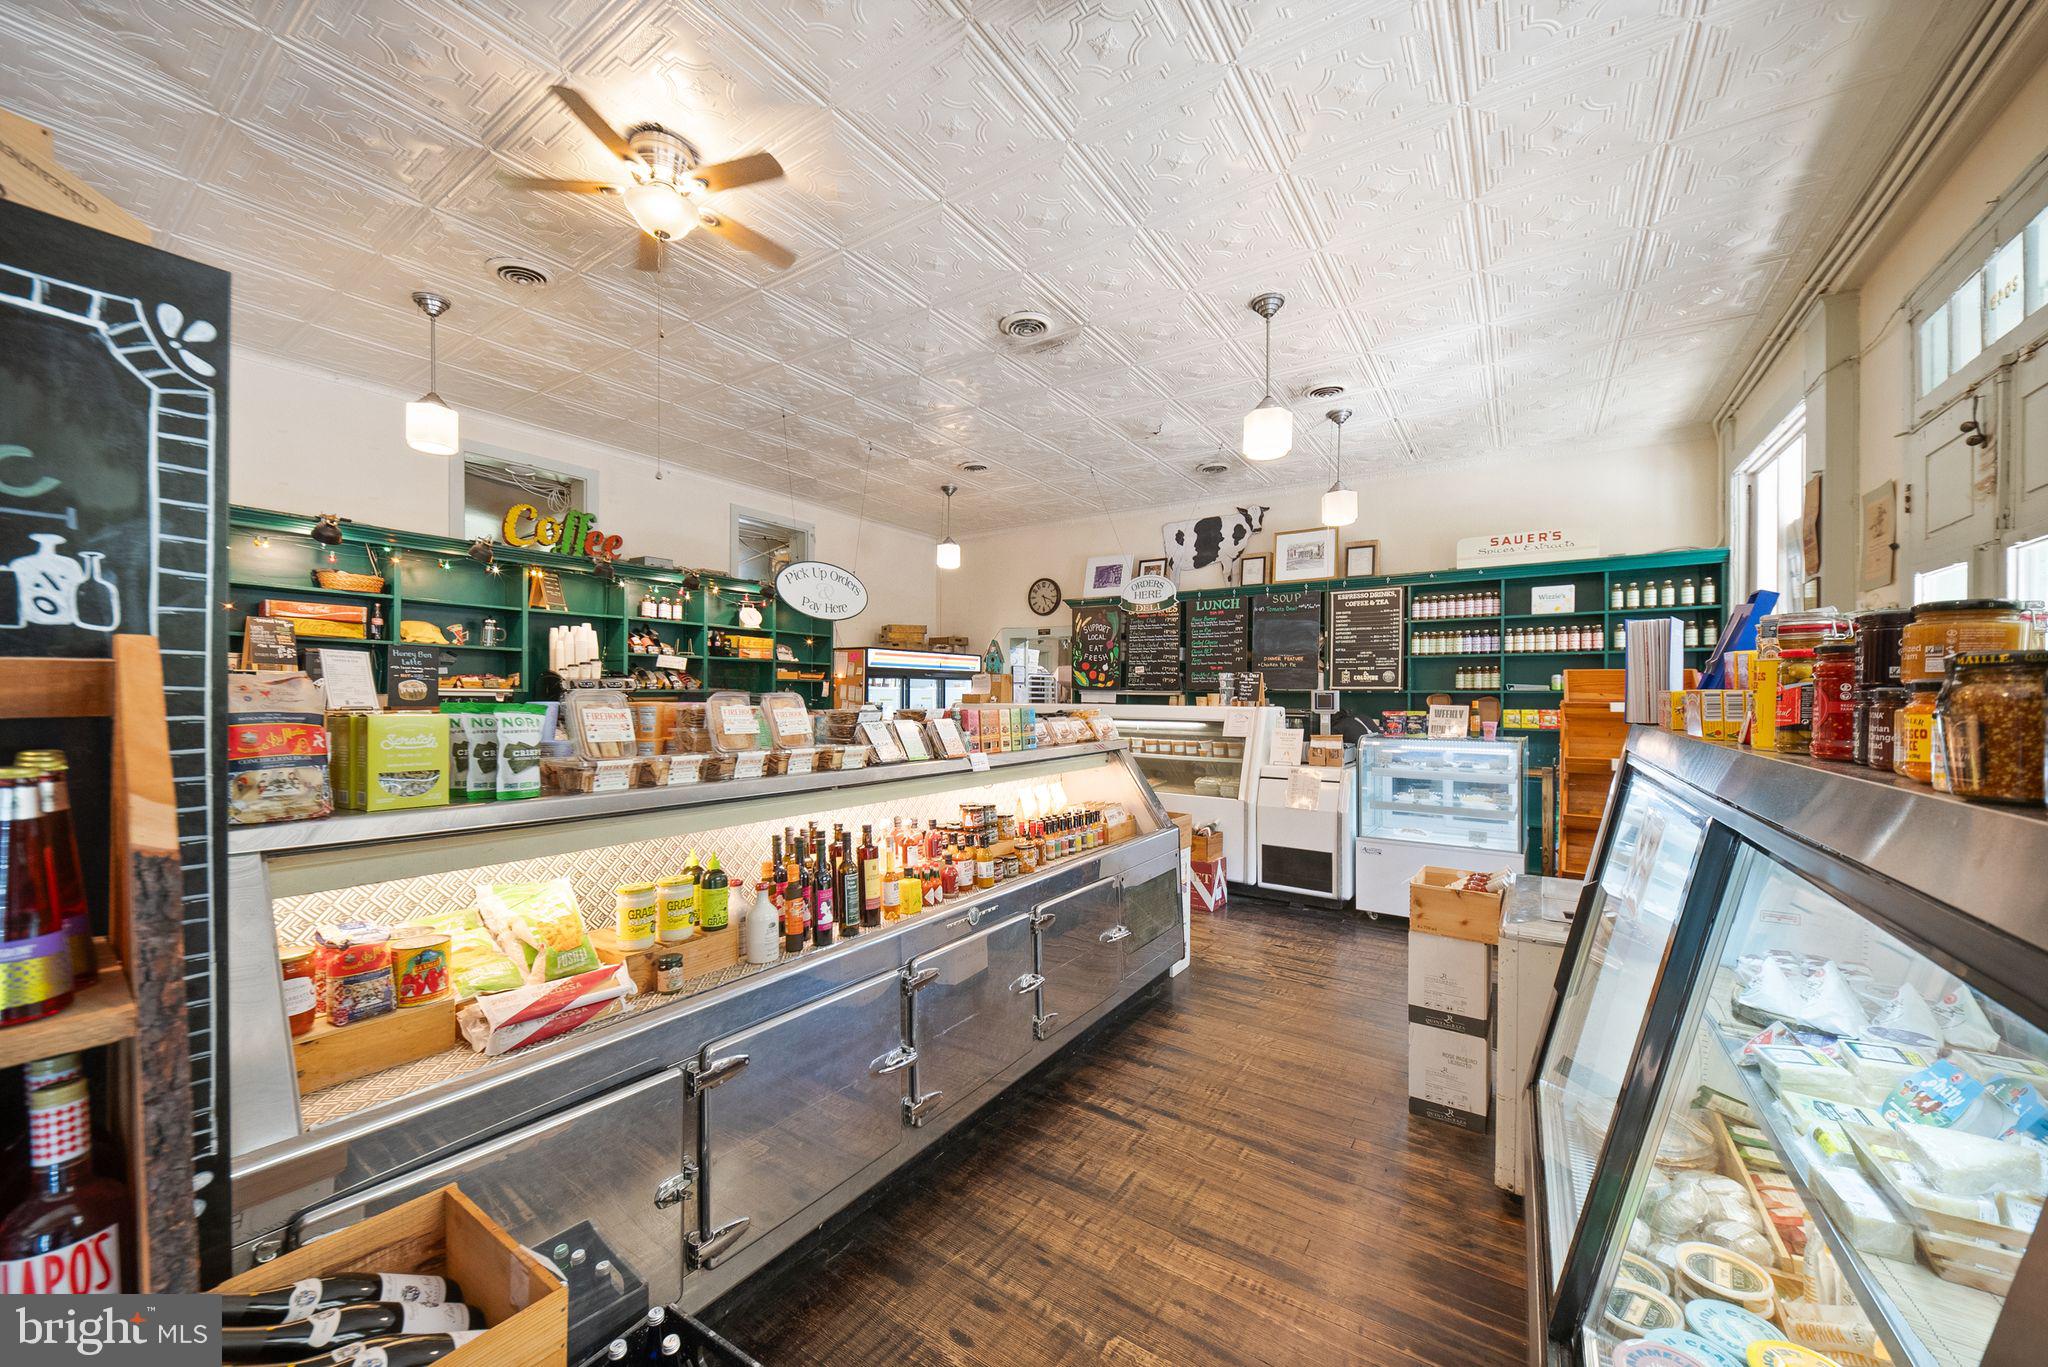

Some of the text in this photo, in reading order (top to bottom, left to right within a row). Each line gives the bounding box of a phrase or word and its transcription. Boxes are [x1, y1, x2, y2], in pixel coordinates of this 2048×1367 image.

[502, 503, 624, 560] Coffee
[1490, 531, 1562, 547] SAUER'S
[784, 567, 862, 597] Pick Up Orders
[1131, 579, 1165, 591] ORDERS
[1134, 589, 1162, 600] HERE
[1272, 592, 1302, 604] SOUP
[1337, 592, 1369, 600] ESPRESSO
[801, 595, 848, 614] Pay Here
[1135, 602, 1161, 612] DELI
[1196, 598, 1241, 611] LUNCH
[1082, 623, 1111, 634] SUPPORT
[1087, 632, 1107, 641] LOCAL
[1089, 644, 1104, 652] EAT
[1083, 653, 1108, 662] FRESH
[585, 712, 627, 721] FIREHOOK
